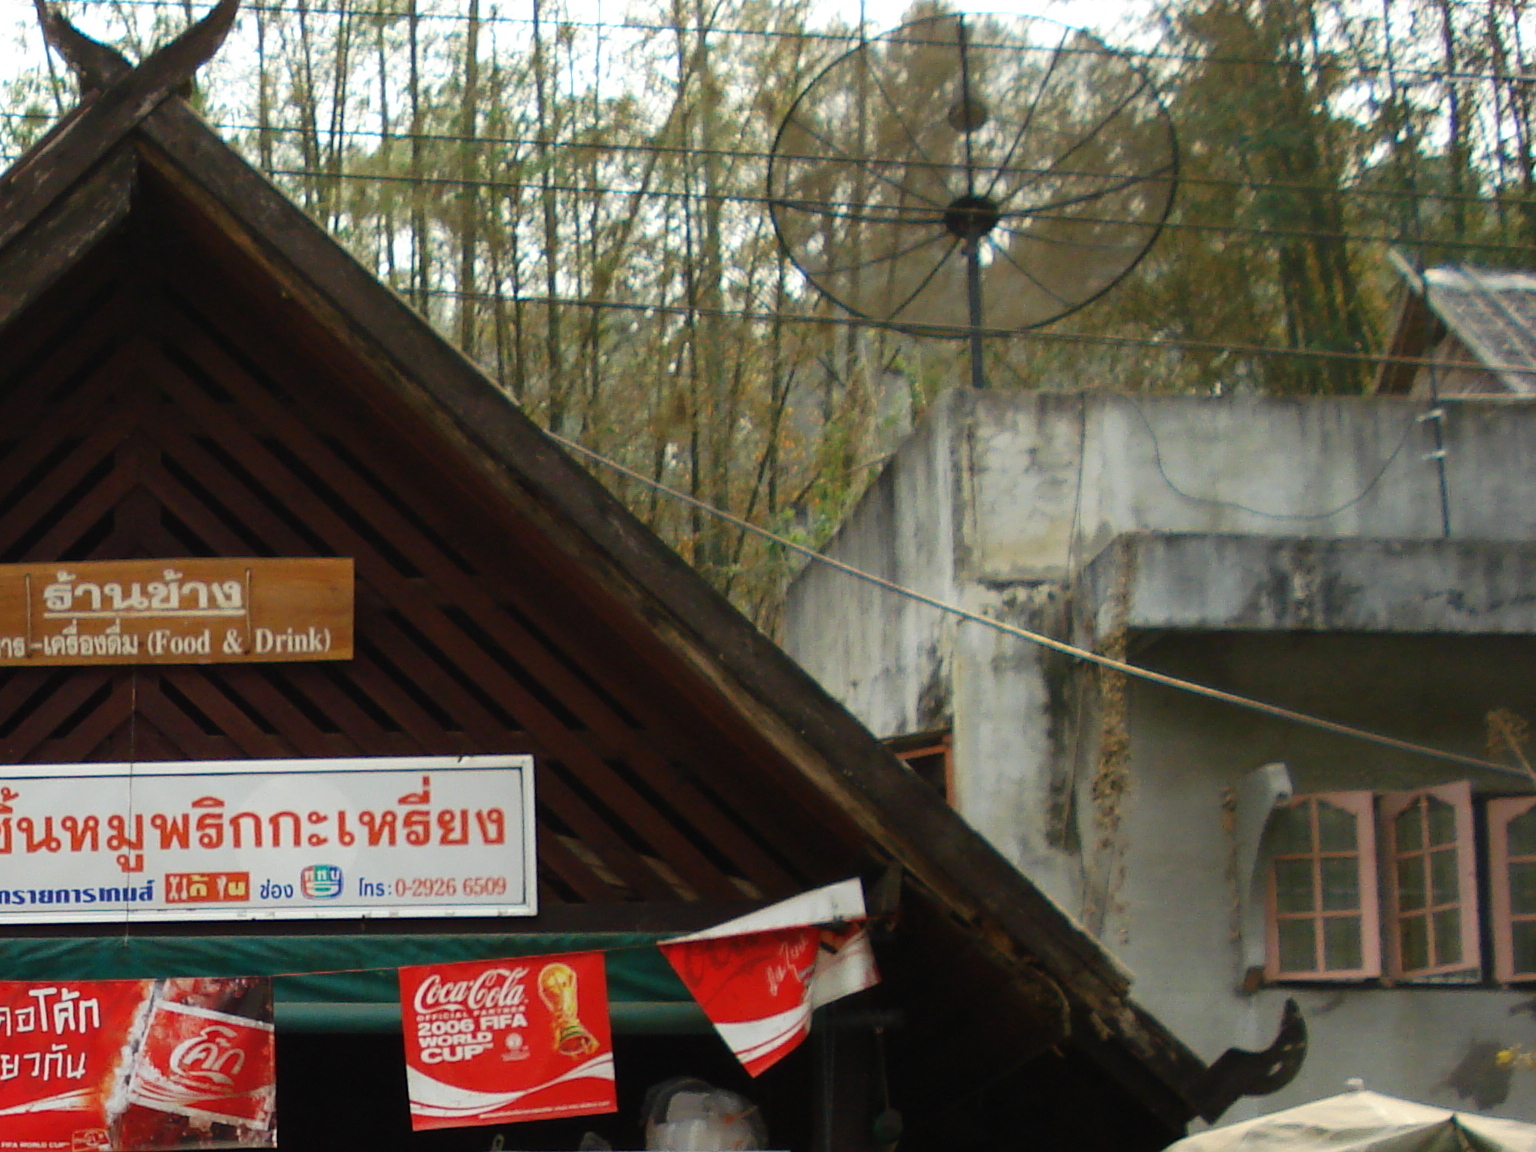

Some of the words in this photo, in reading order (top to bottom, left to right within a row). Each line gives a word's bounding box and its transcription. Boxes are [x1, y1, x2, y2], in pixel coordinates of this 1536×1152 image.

[148, 628, 211, 657] (Food
[222, 628, 244, 656] &
[254, 626, 332, 654] Drink)
[260, 879, 295, 900] ช่อง
[463, 875, 508, 896] 6509
[413, 966, 530, 1014] Coca-Cola
[417, 1018, 475, 1037] 2006
[480, 1013, 529, 1031] FIFA
[418, 1031, 494, 1049] WORLD
